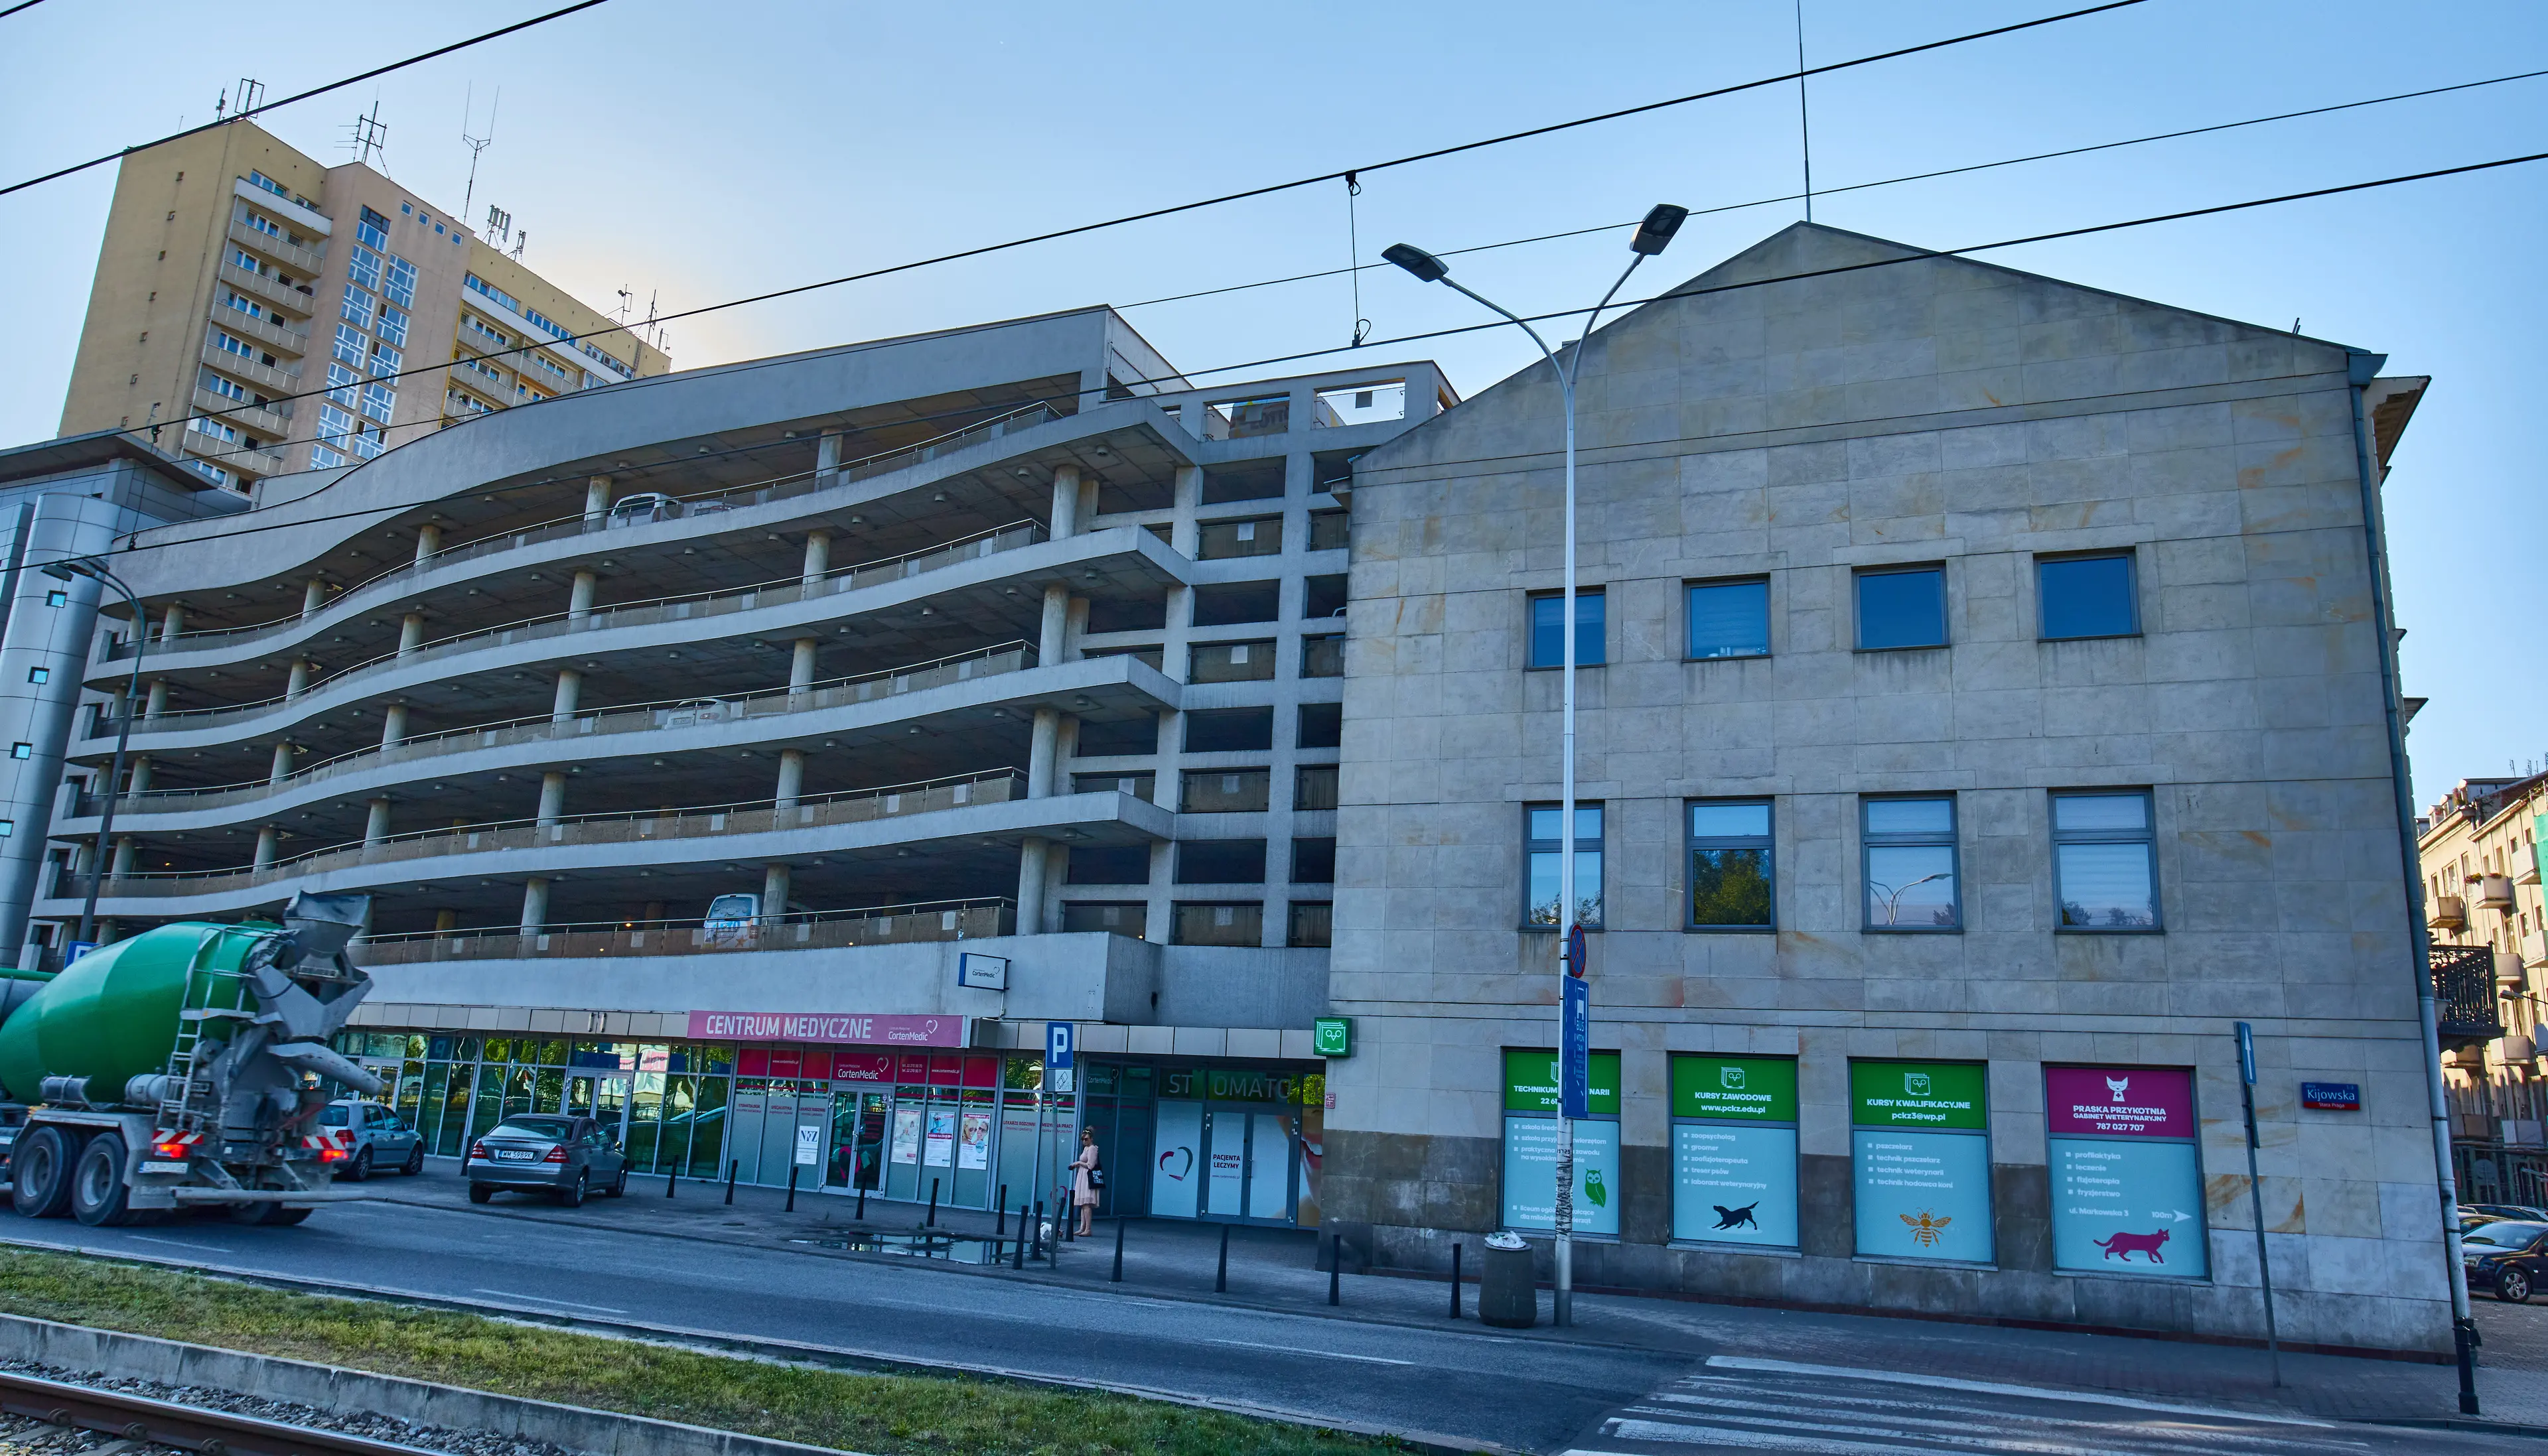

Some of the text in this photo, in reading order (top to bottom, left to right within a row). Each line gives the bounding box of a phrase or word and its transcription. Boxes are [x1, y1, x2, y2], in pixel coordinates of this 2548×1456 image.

[706, 1015, 873, 1039] CENTRUM MEDYCZNE
[1576, 1020, 1585, 1031] BUS
[888, 1031, 928, 1041] CortenMedic
[1052, 1027, 1068, 1063] P
[837, 1069, 879, 1080] CortenMedic
[1088, 1076, 1113, 1085] CortenMedic
[1514, 1085, 1557, 1094] TECHNIKUM
[1722, 1092, 1772, 1102] ZAWODOWE
[2307, 1089, 2355, 1101] Kijowska
[1701, 1104, 1766, 1114] www.pckz.edu.pl
[1896, 1100, 1971, 1109] KWALIFIKACYJNE
[2110, 1106, 2166, 1115] PRZYKOTNIA
[1892, 1112, 1946, 1121] pckz3@wp.pl
[800, 1130, 818, 1142] NFZ
[1691, 1132, 1736, 1142] zoopsycholog
[1541, 1136, 1557, 1146] przyj
[1521, 1146, 1556, 1155] praktyczna
[1691, 1156, 1748, 1164] zoofizjoterapeuta
[2075, 1152, 2121, 1160] profilaktyka
[1720, 1181, 1767, 1189] weterynaryjny
[2076, 1176, 2120, 1185] fizjoterapia
[2078, 1189, 2121, 1197] fryzjerstwo
[2079, 1207, 2123, 1216] Markowska
